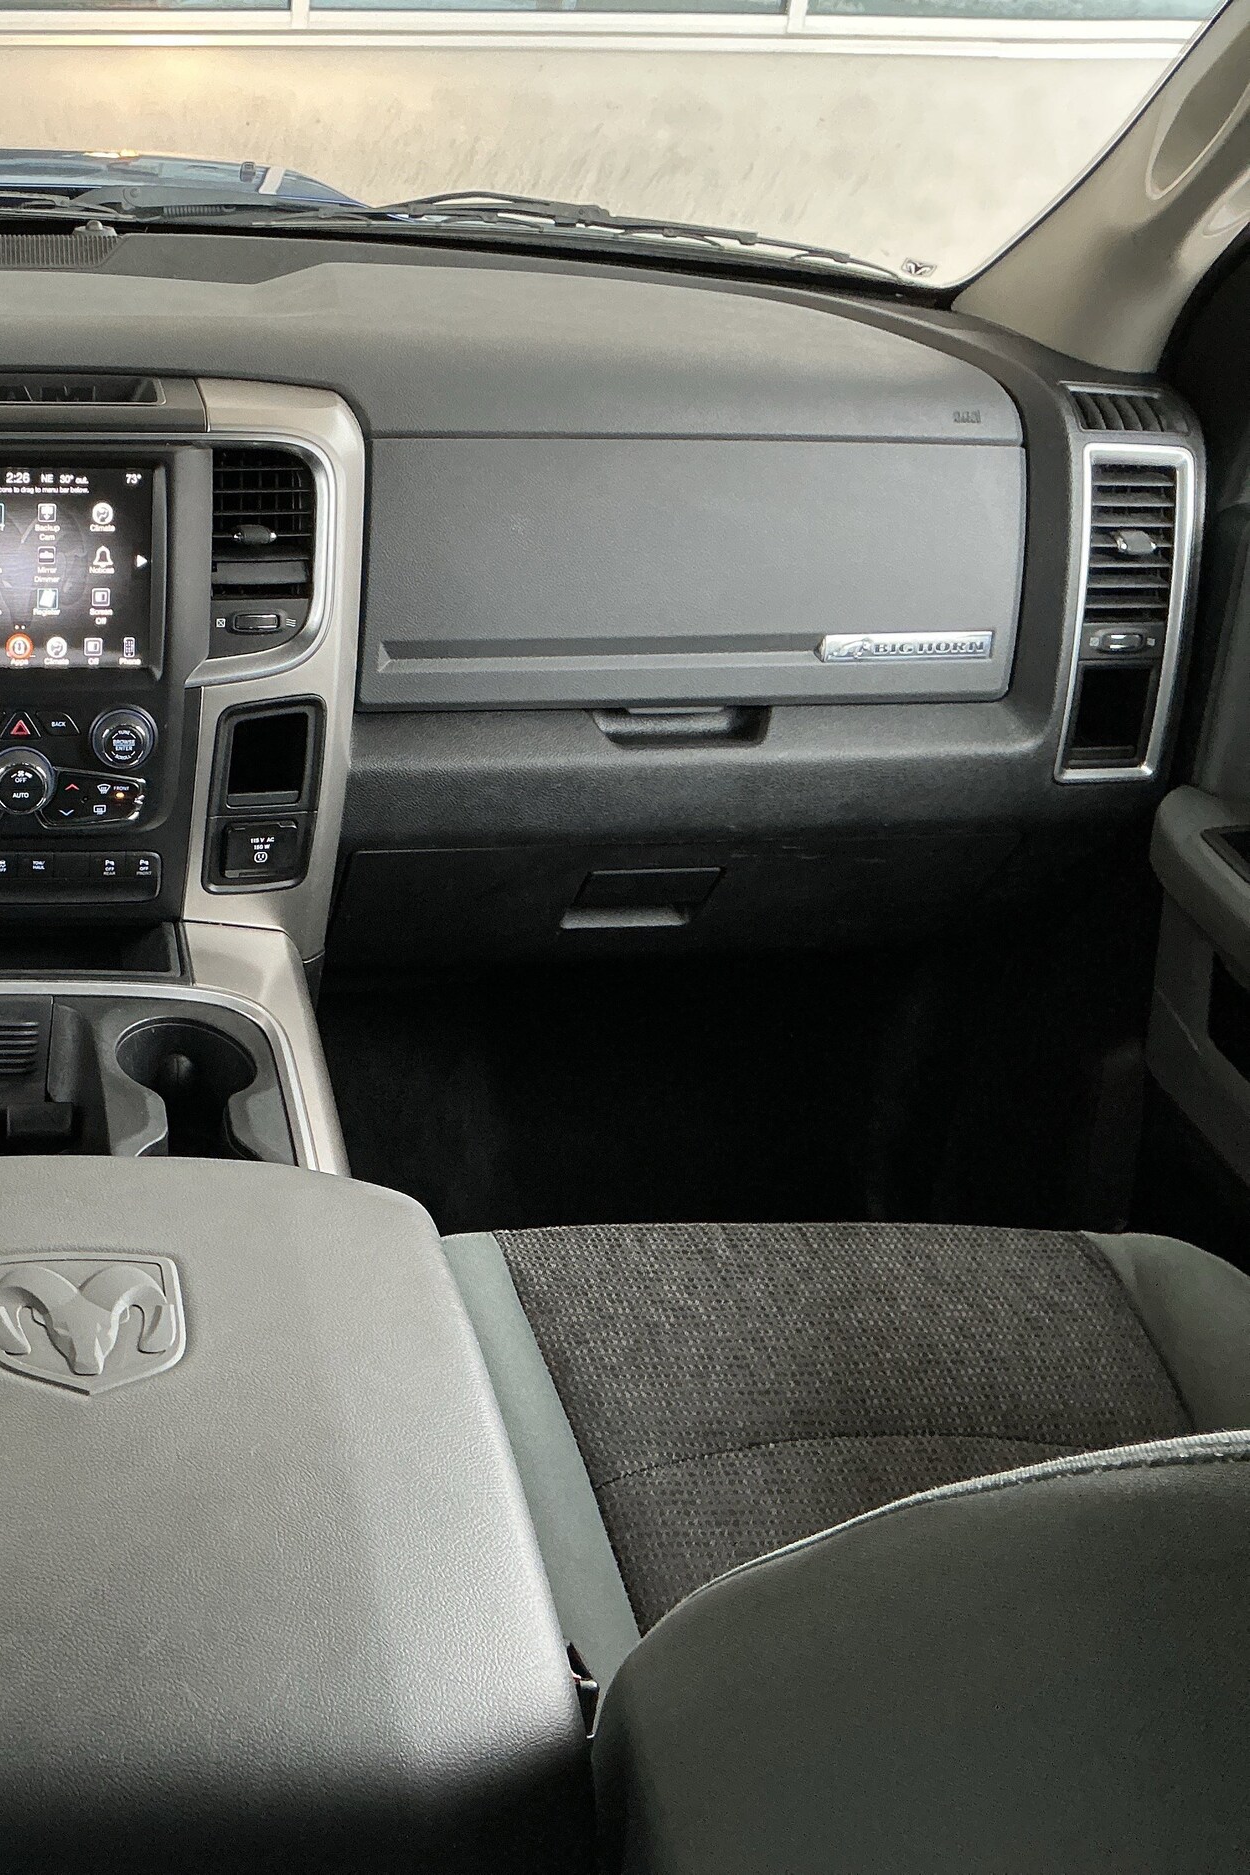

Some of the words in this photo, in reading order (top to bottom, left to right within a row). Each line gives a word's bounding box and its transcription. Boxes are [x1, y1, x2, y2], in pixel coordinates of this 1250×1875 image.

[6, 472, 30, 484] 2:26
[40, 474, 54, 484] NE
[872, 643, 913, 656] BIG
[916, 641, 984, 654] HORN
